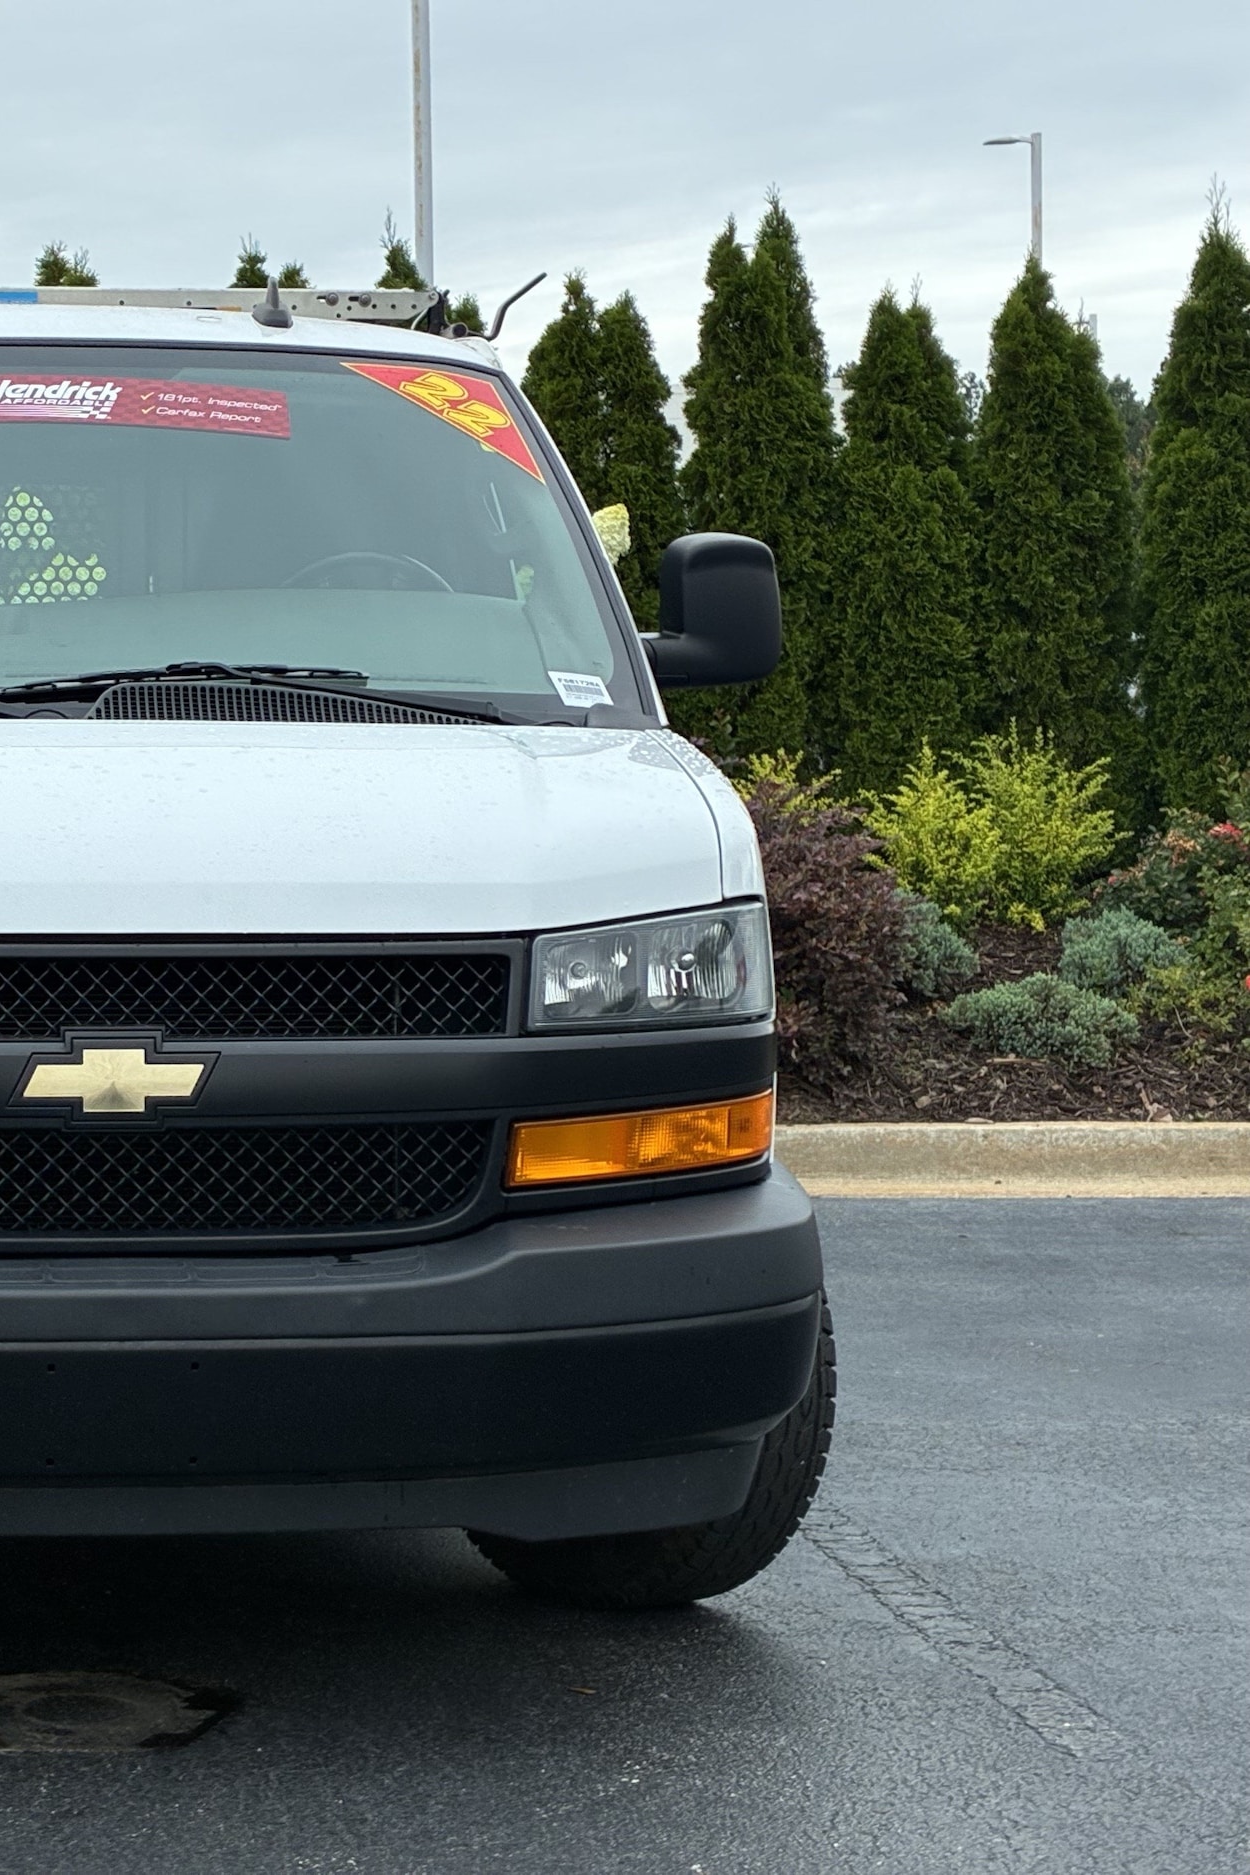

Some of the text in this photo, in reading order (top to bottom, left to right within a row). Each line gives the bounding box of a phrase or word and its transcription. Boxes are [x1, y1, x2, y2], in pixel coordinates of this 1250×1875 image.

[0, 398, 115, 407] AFFORDABLE
[399, 372, 511, 438] 22
[156, 406, 262, 423] Carfax Report
